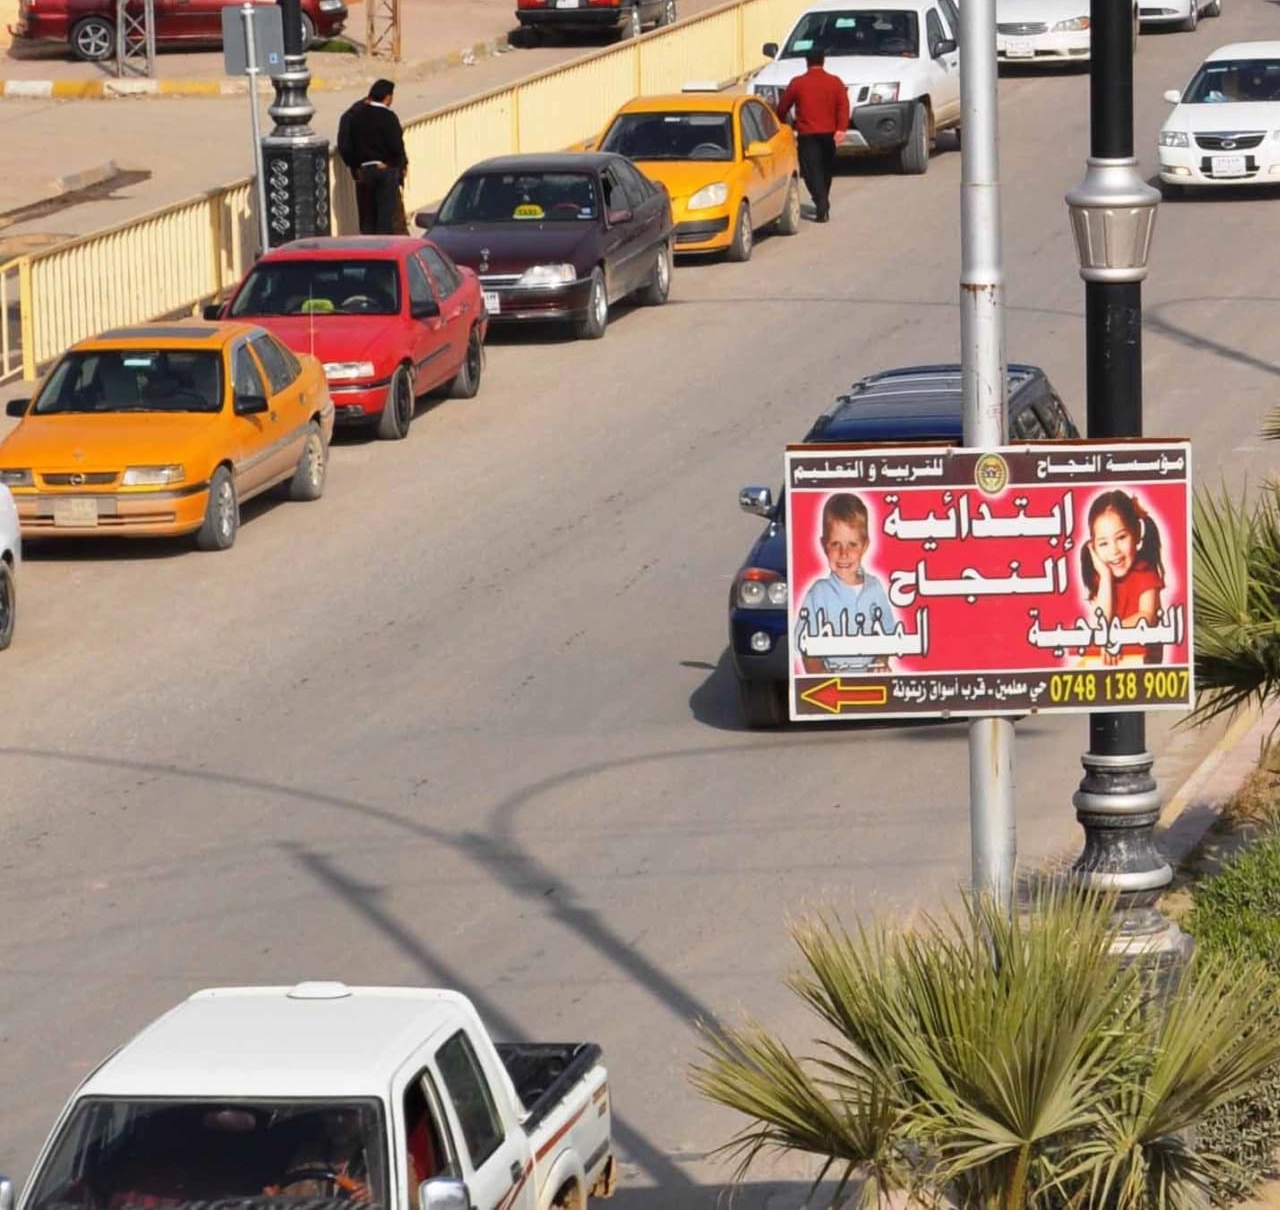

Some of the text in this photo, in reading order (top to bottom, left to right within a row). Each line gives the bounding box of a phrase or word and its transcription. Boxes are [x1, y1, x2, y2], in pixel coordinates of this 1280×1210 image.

[793, 453, 1185, 484] مؤسسة النجاح للتربية و التعليم
[888, 553, 1070, 608] النجاح
[796, 602, 1185, 658] النموذجية المختلطة
[961, 677, 987, 702] قرب
[1049, 670, 1189, 702] 0748 138 9007
